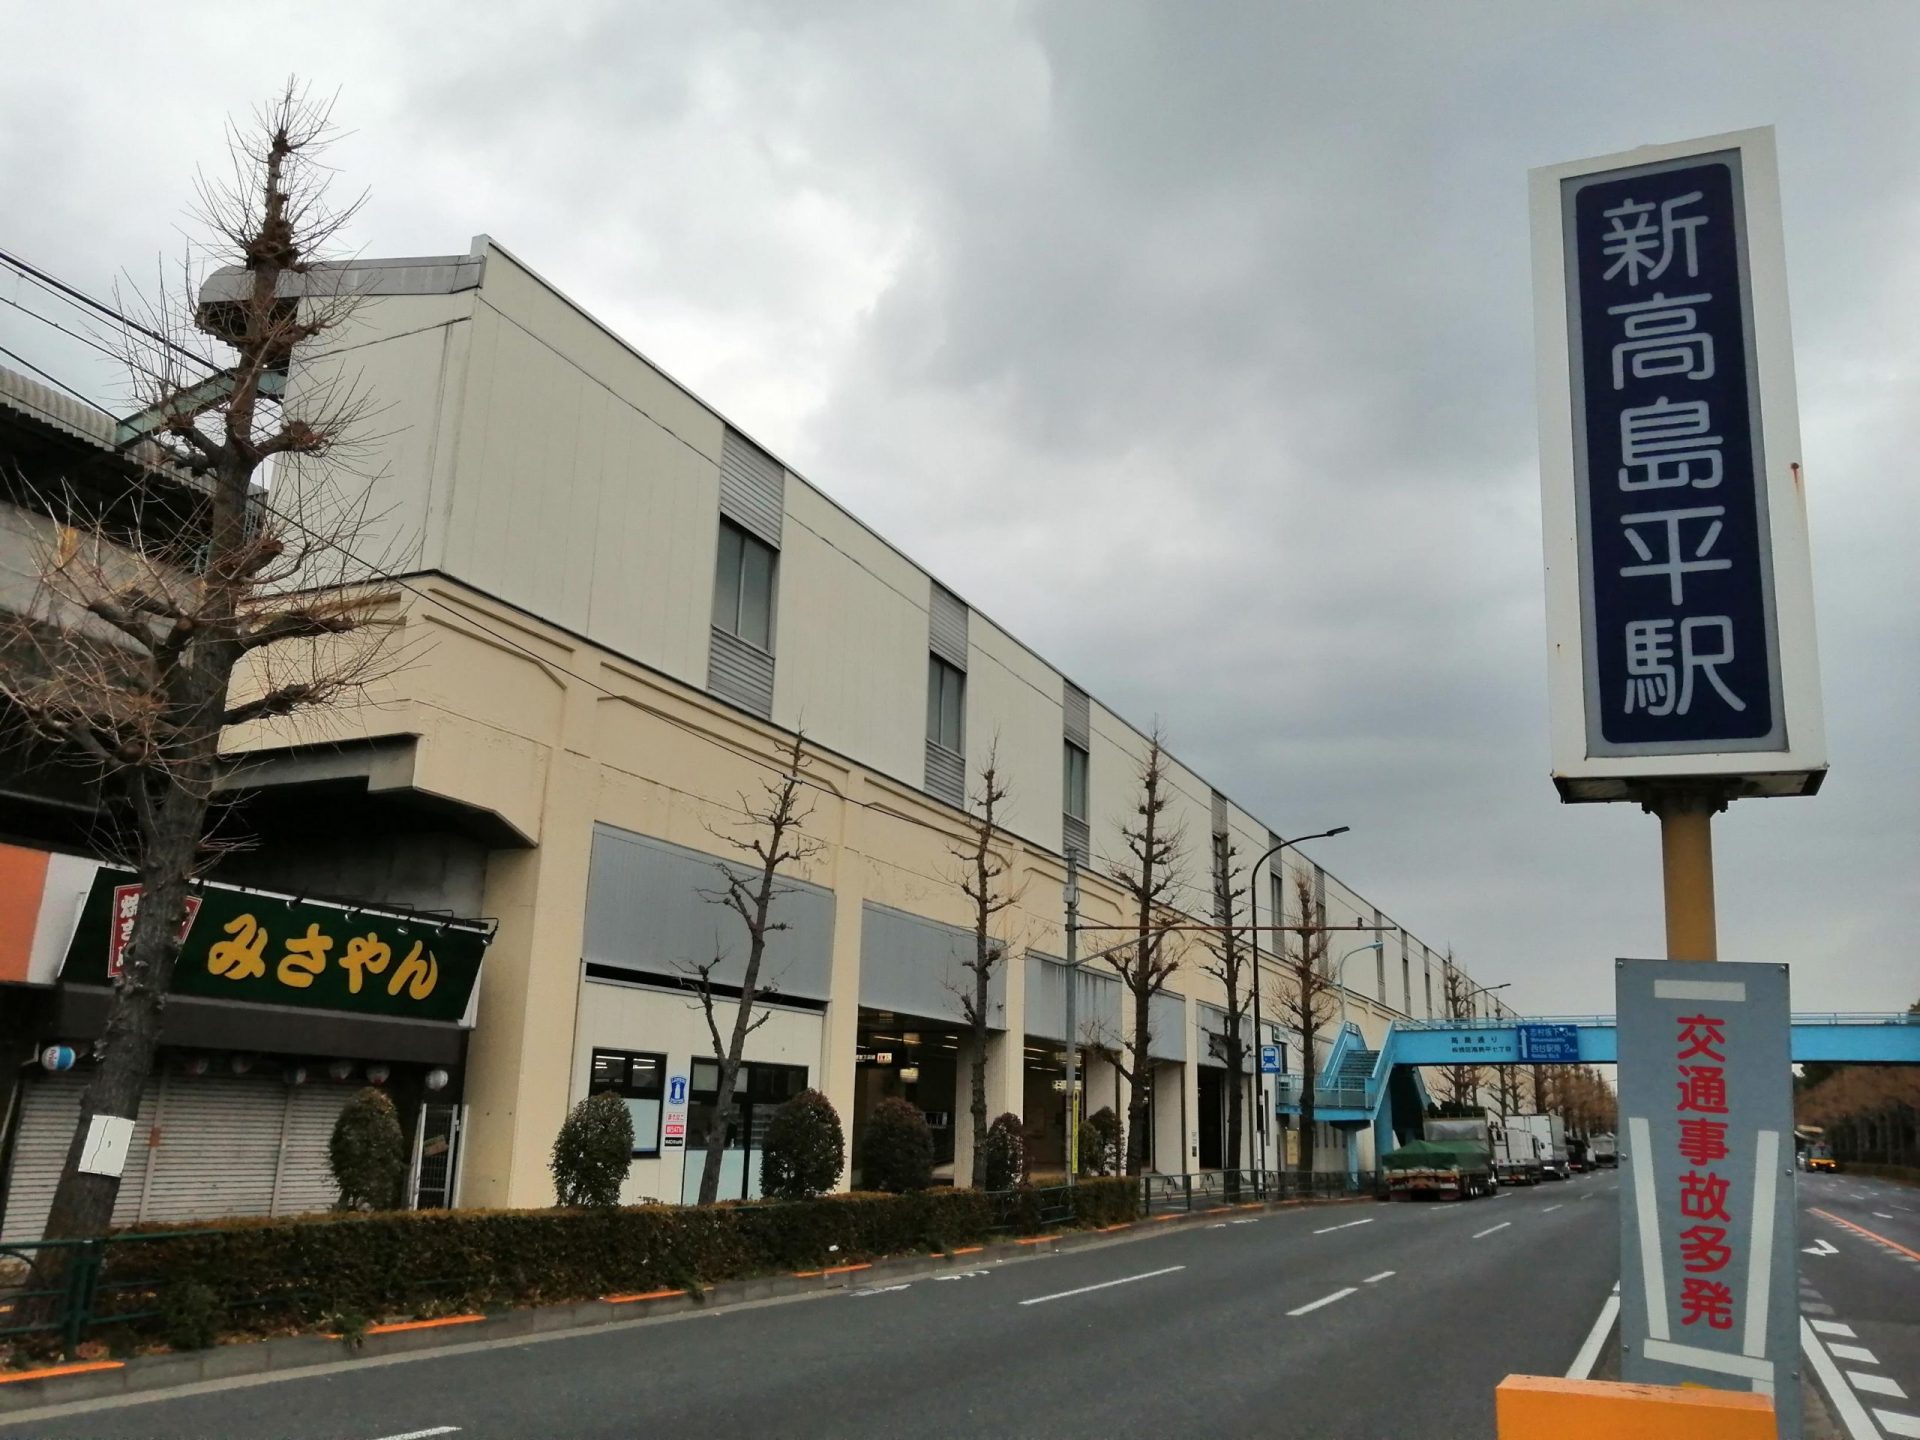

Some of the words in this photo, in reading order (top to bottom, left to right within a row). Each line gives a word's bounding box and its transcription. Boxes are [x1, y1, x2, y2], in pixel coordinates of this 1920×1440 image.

[1603, 190, 1746, 716] 新高島平駅
[207, 913, 438, 1000] みさやん
[1677, 1014, 1733, 1330] 交通事故多発
